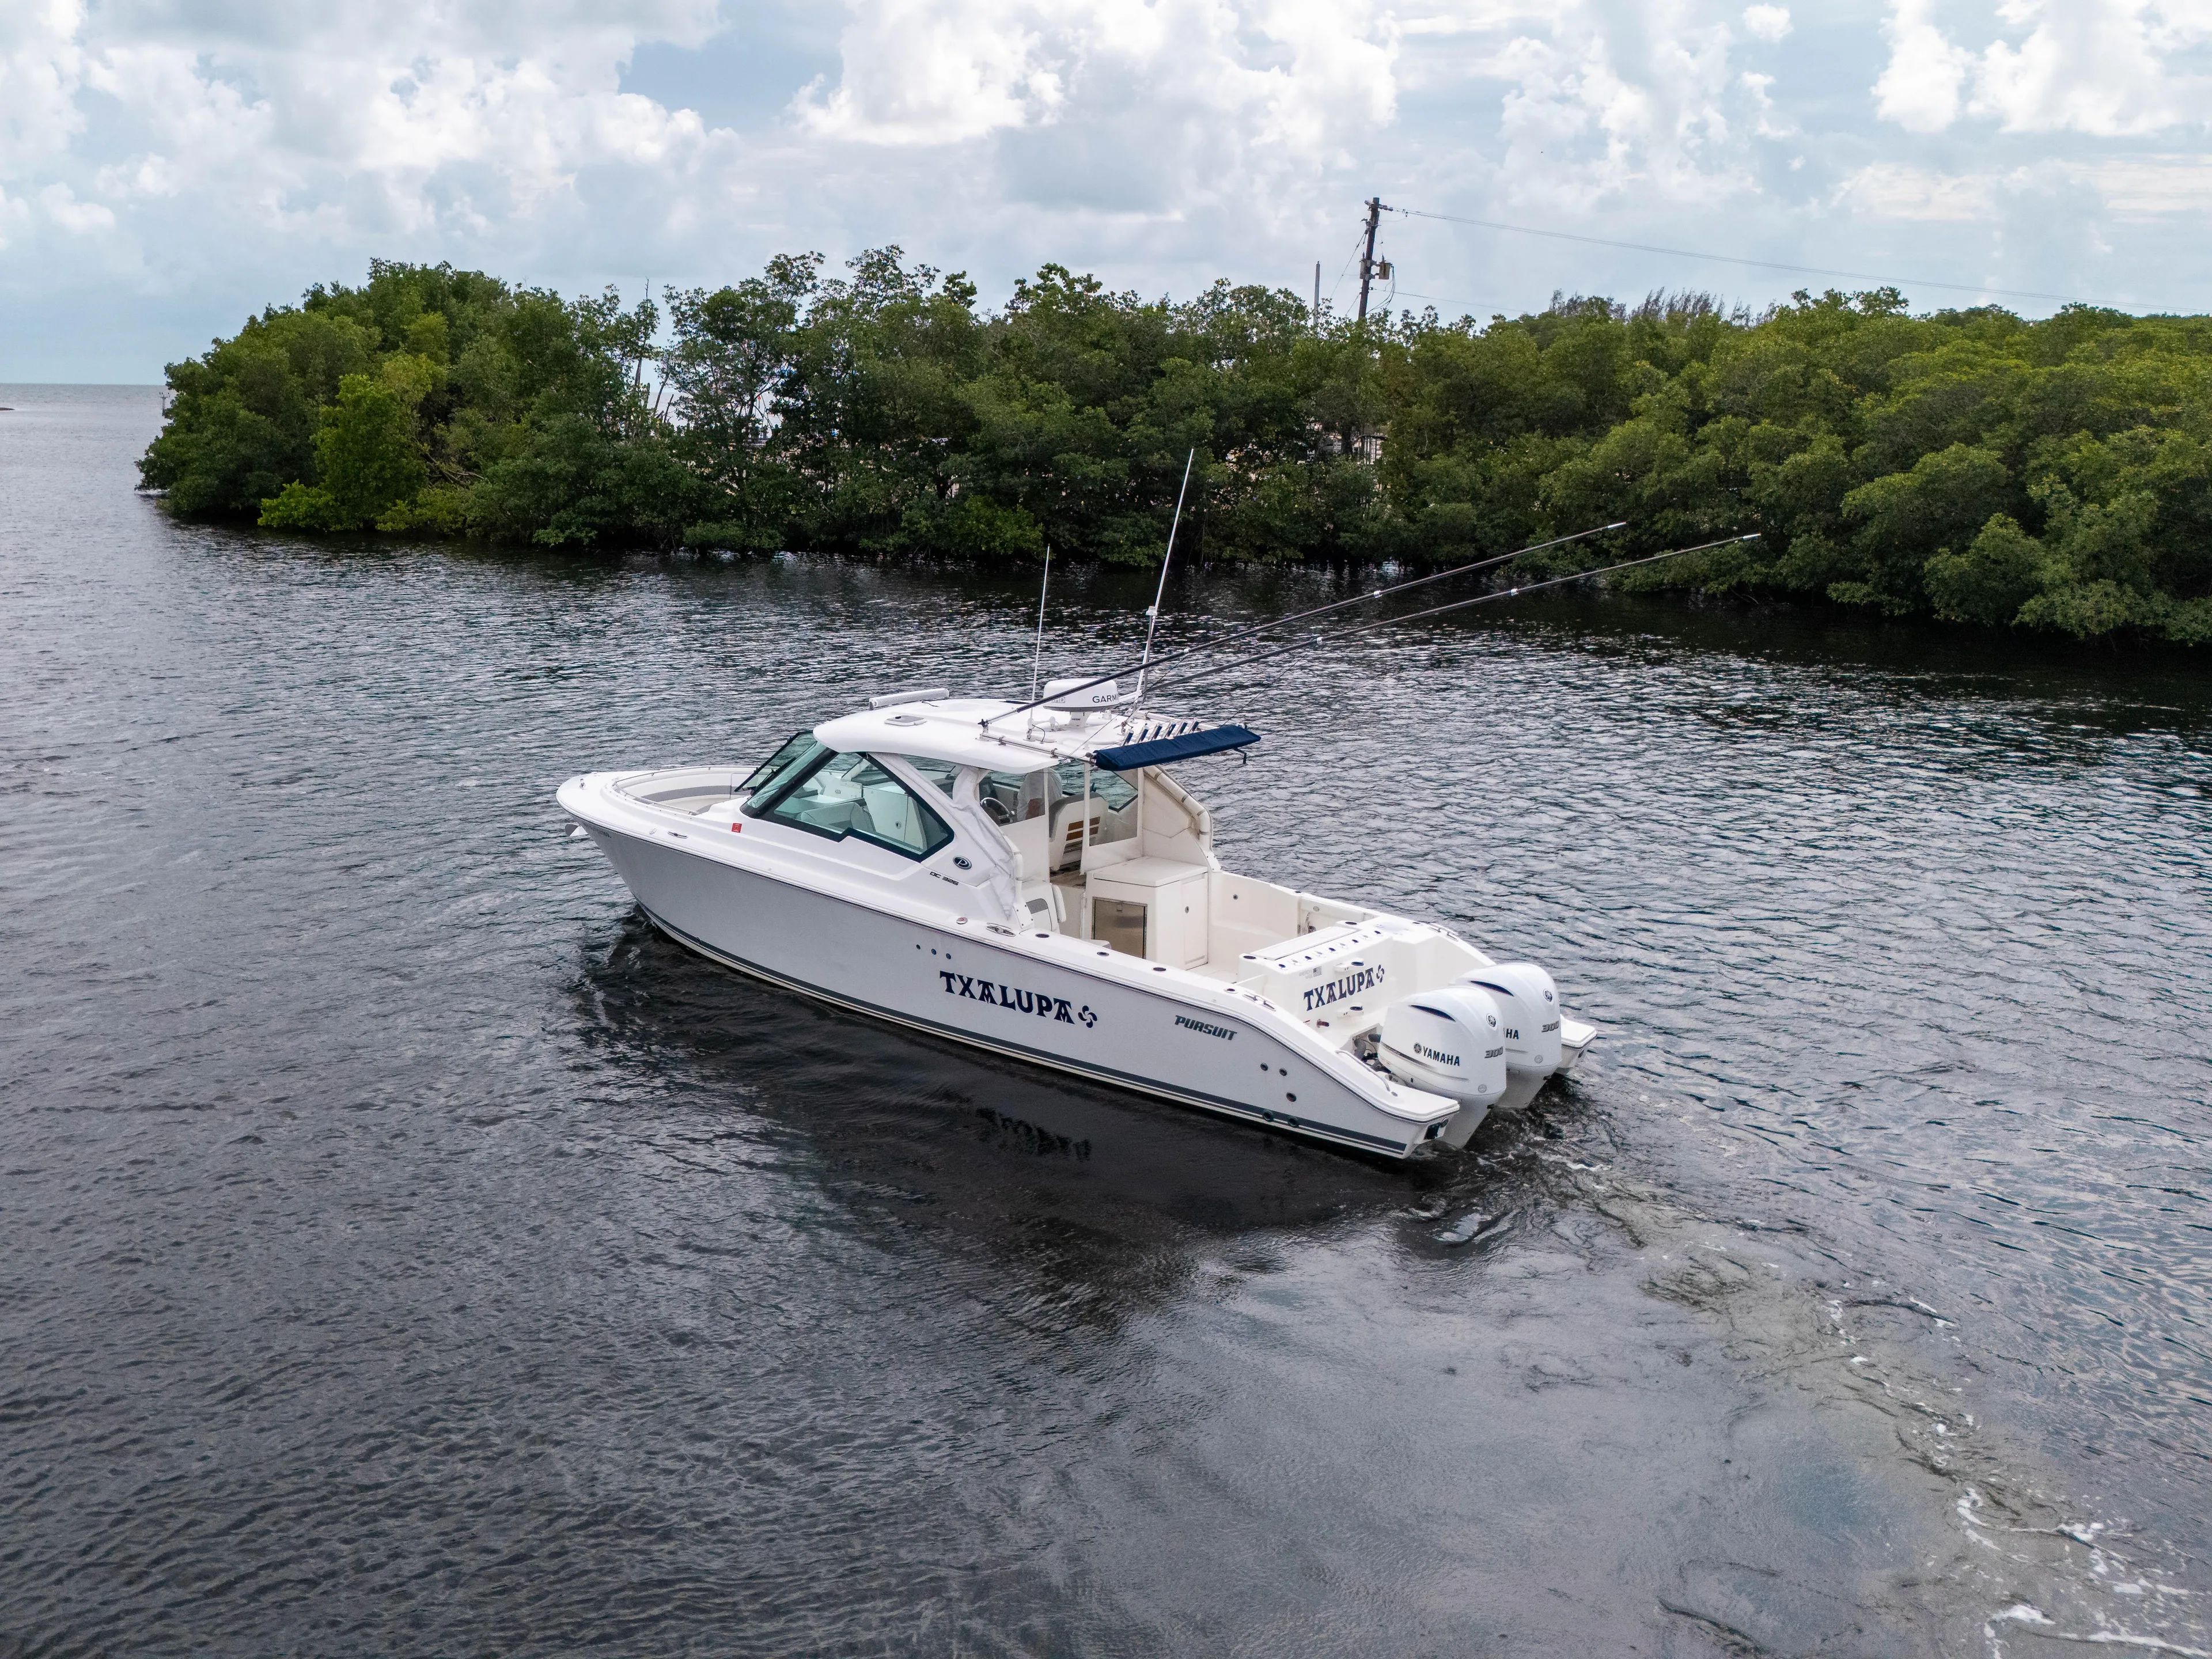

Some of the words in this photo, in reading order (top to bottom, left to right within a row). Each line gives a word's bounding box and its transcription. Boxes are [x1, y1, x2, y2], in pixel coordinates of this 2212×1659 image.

[940, 971, 1075, 1025] TXALUPA
[1303, 967, 1375, 1012] TXALUPA
[1175, 1015, 1237, 1041] PURSUIT
[1541, 1020, 1559, 1033] 300
[1422, 1046, 1460, 1066] YAMAHA
[1484, 1046, 1503, 1059] 300
